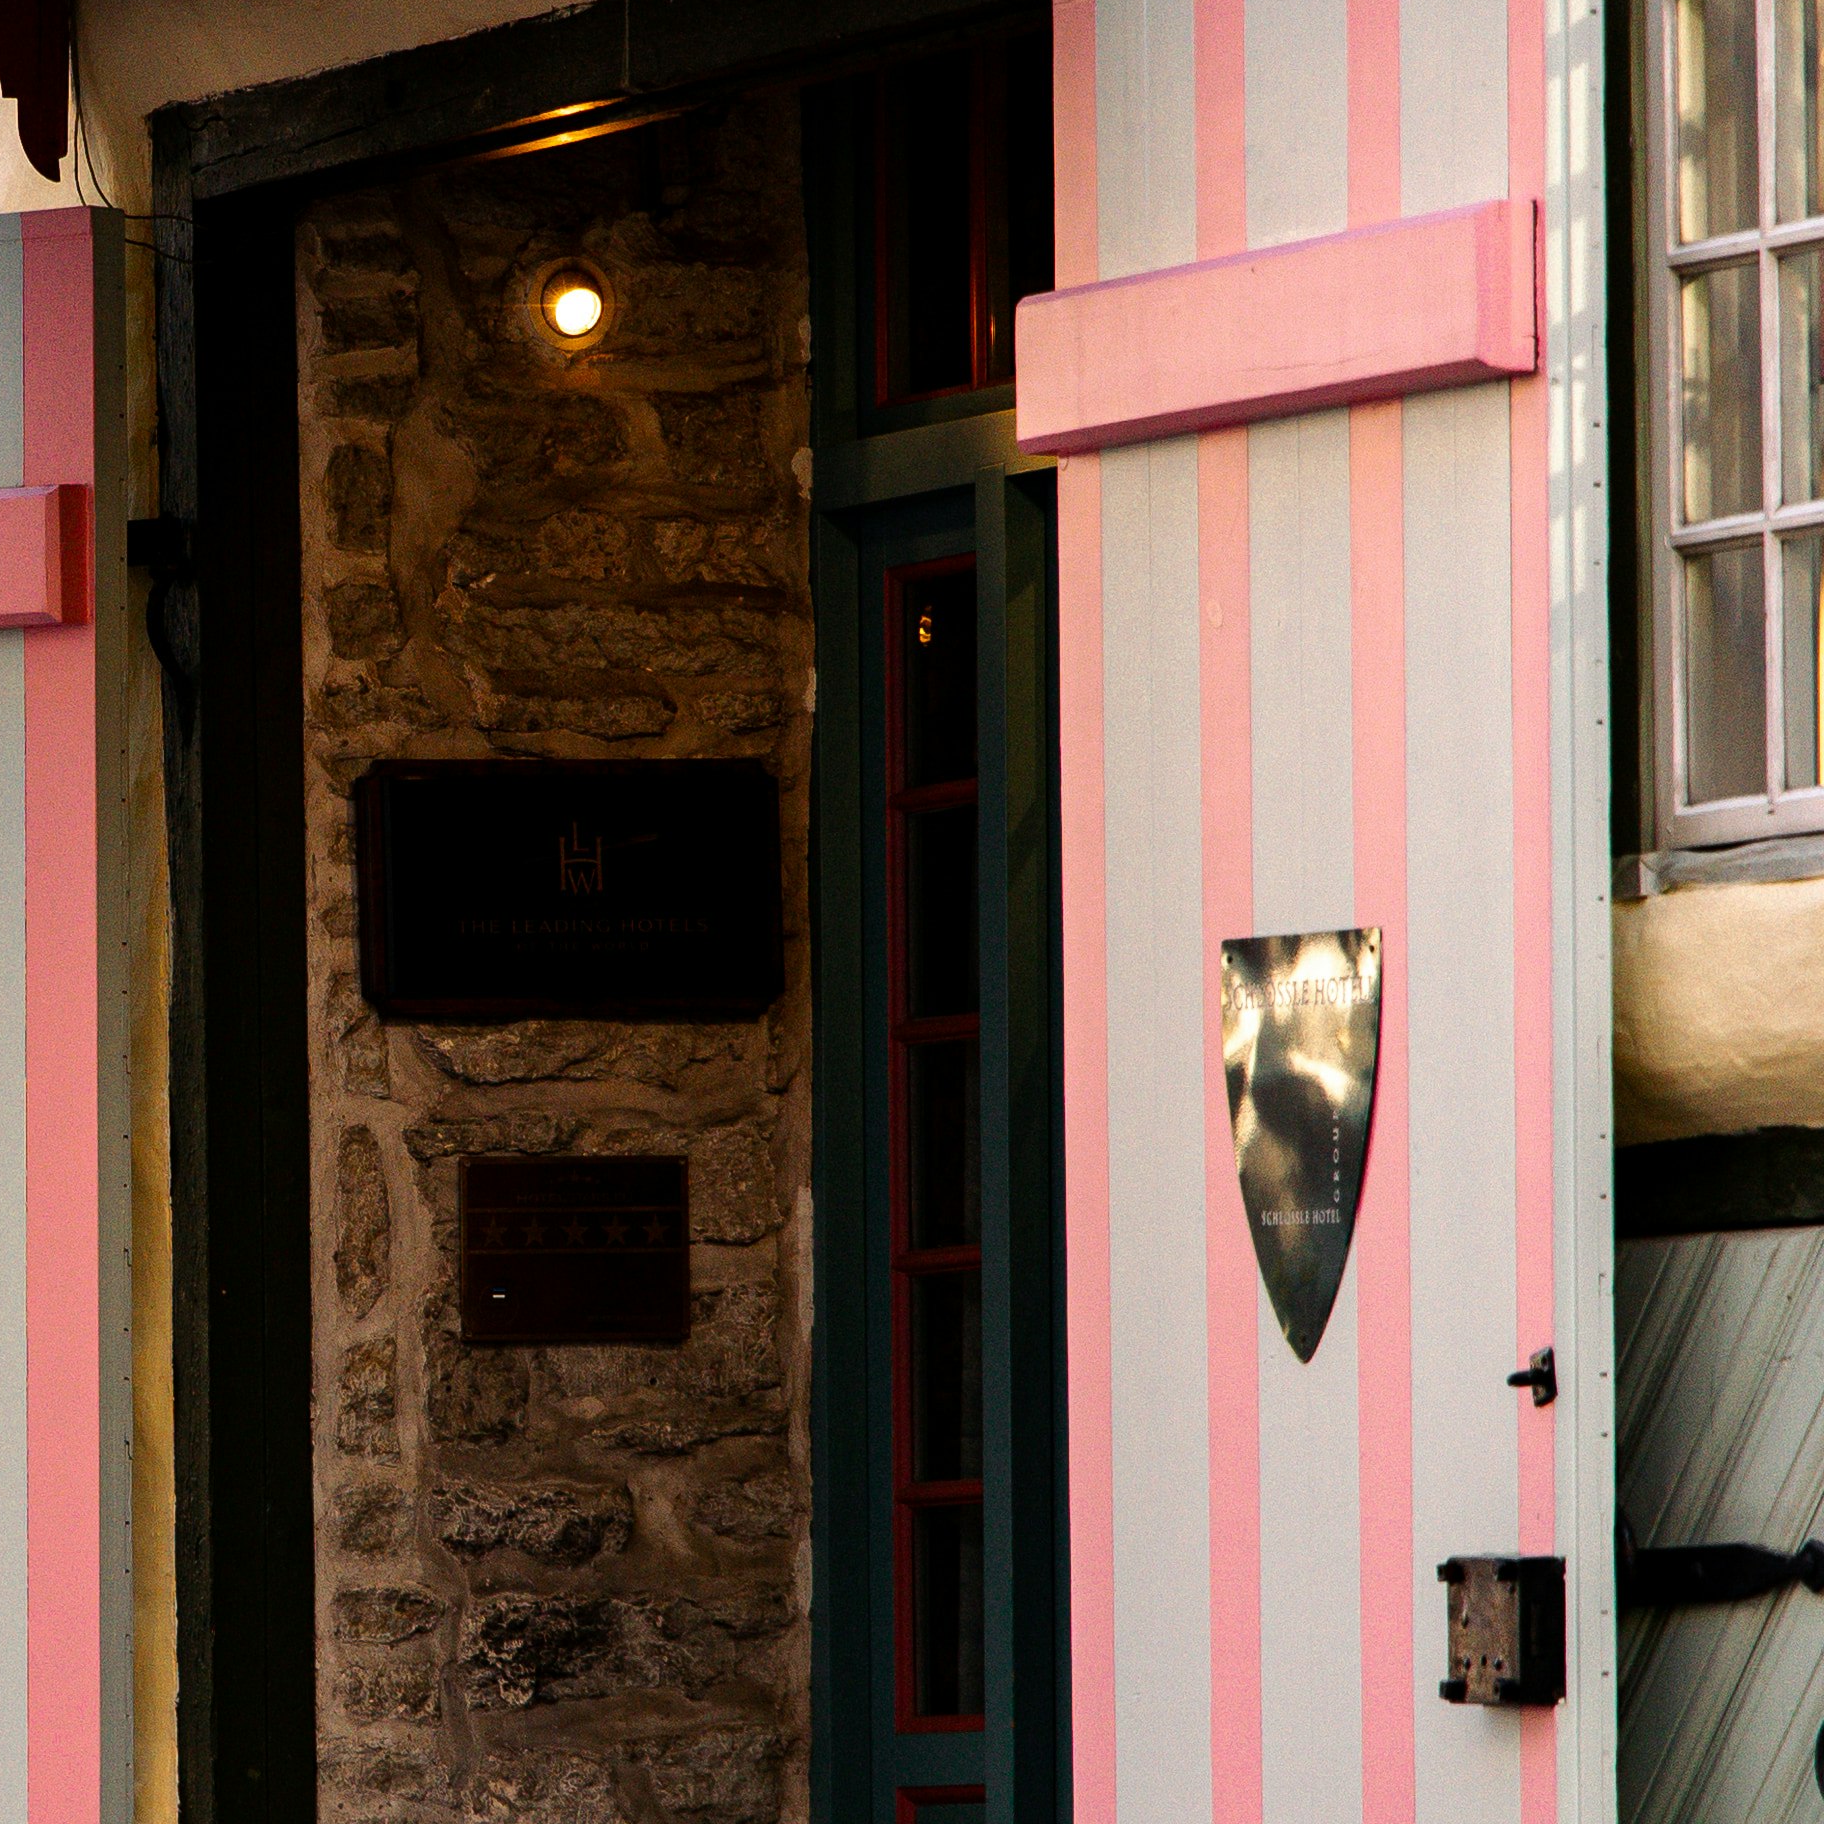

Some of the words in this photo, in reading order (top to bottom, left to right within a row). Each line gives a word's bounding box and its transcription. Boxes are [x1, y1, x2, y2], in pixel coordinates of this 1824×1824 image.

[457, 919, 501, 935] THE
[511, 918, 611, 935] LEADING
[621, 917, 710, 934] HOTELS
[1312, 1209, 1340, 1225] HOTEL
